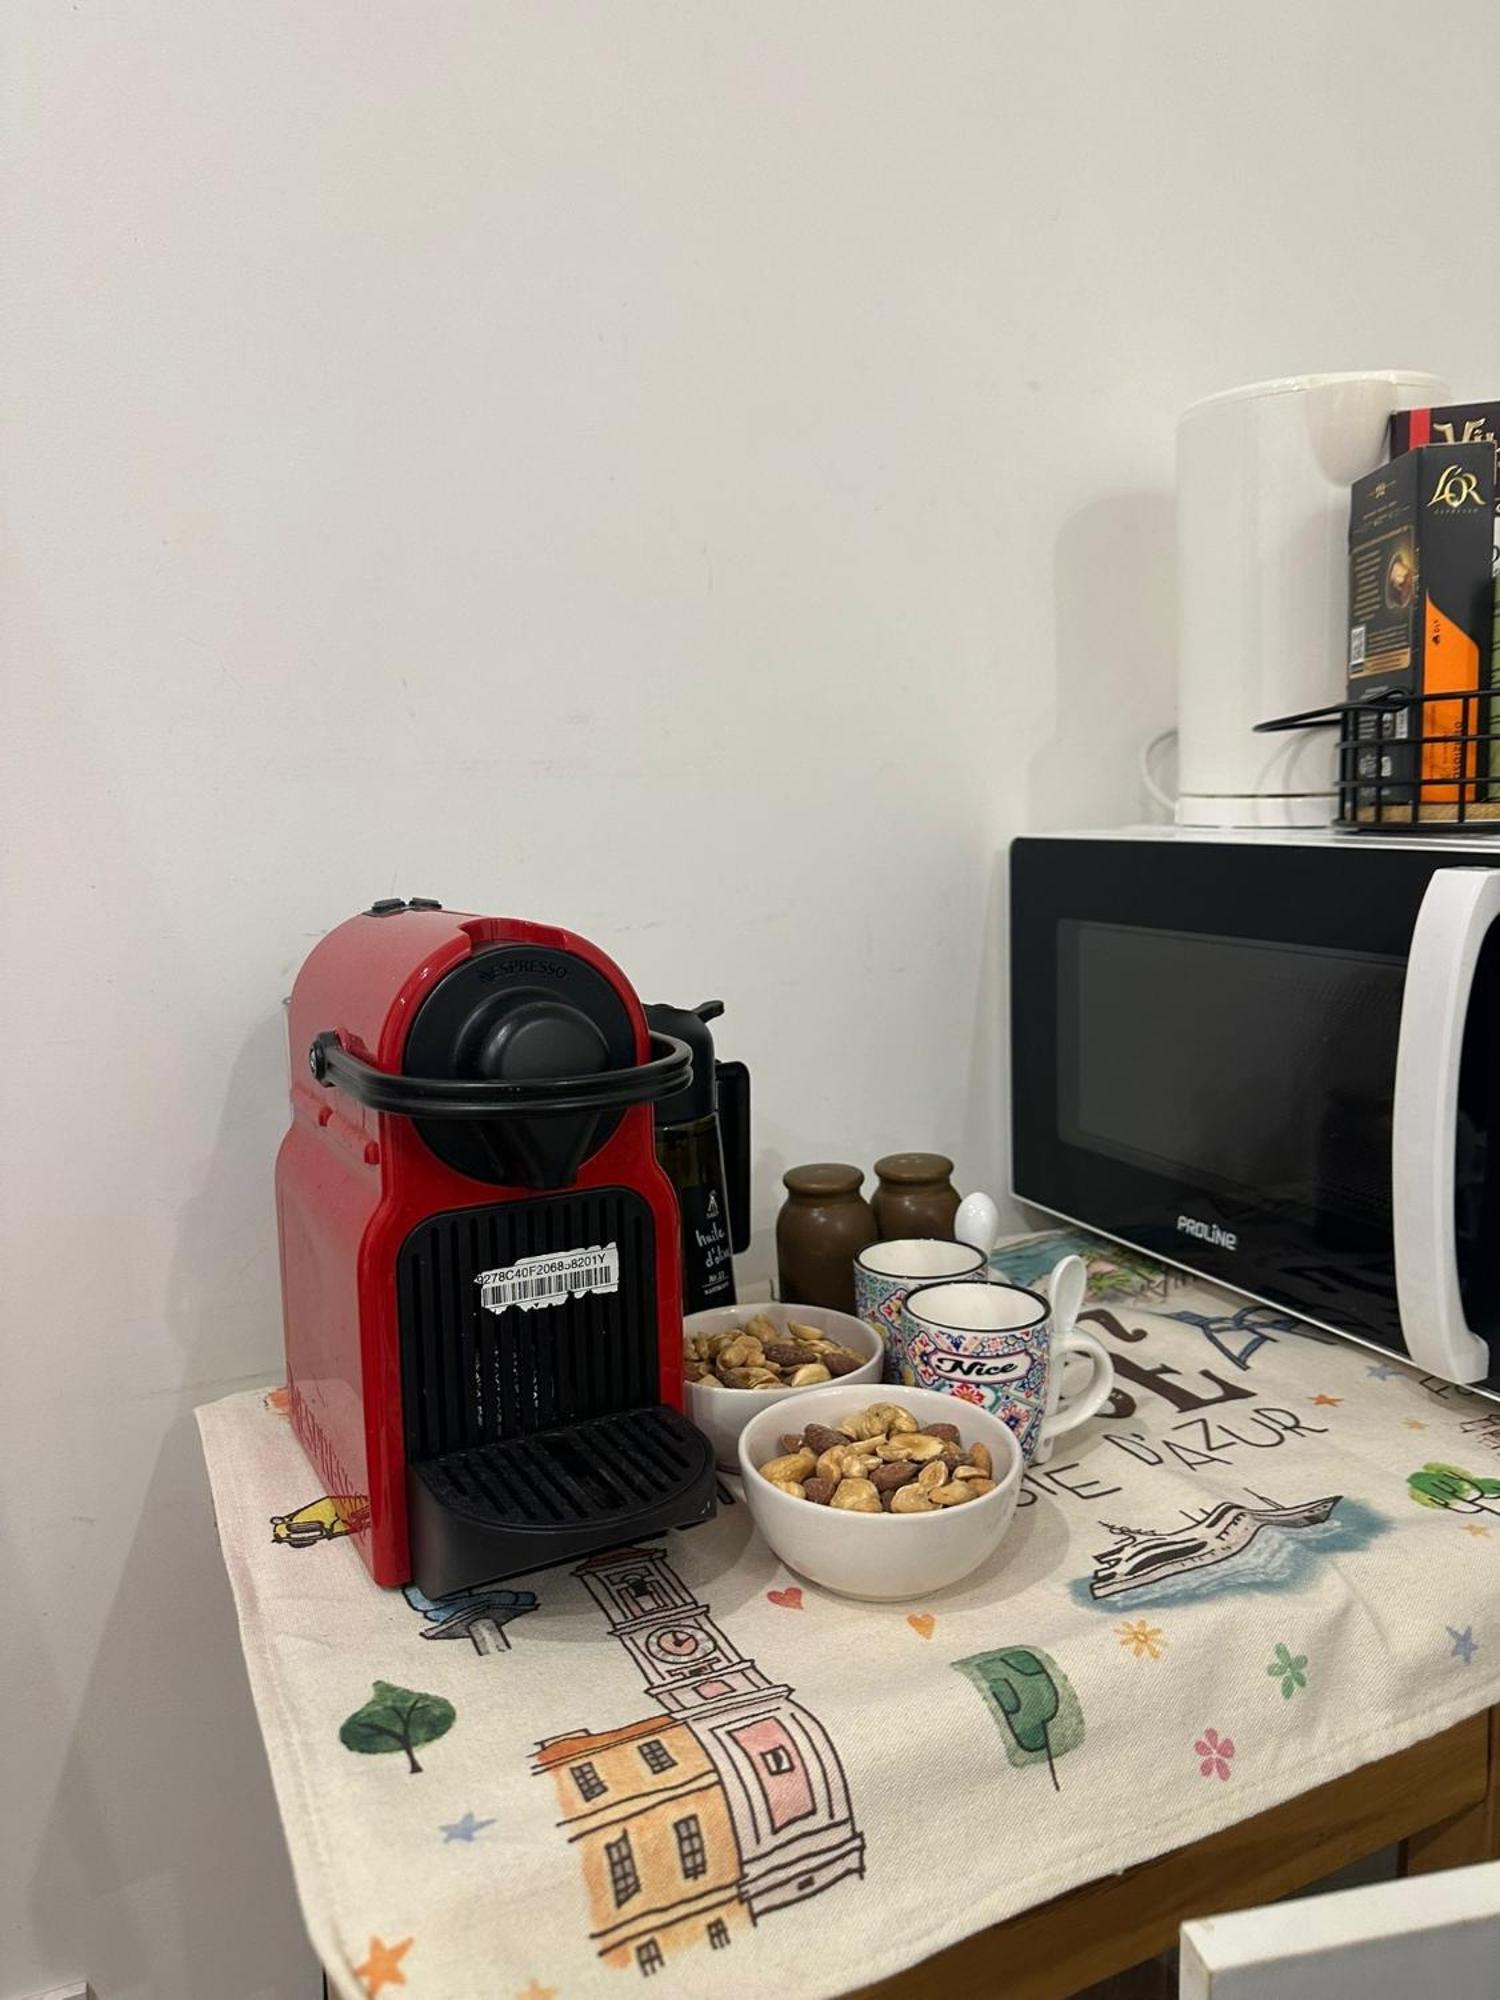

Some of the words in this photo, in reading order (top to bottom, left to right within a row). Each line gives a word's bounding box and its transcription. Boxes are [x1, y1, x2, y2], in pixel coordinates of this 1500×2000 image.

[1427, 465, 1487, 508] L'OR
[478, 959, 568, 984] NESPRESSO
[695, 1221, 726, 1247] huile
[935, 1357, 1019, 1376] Nice
[1102, 1407, 1329, 1471] D'AZUR
